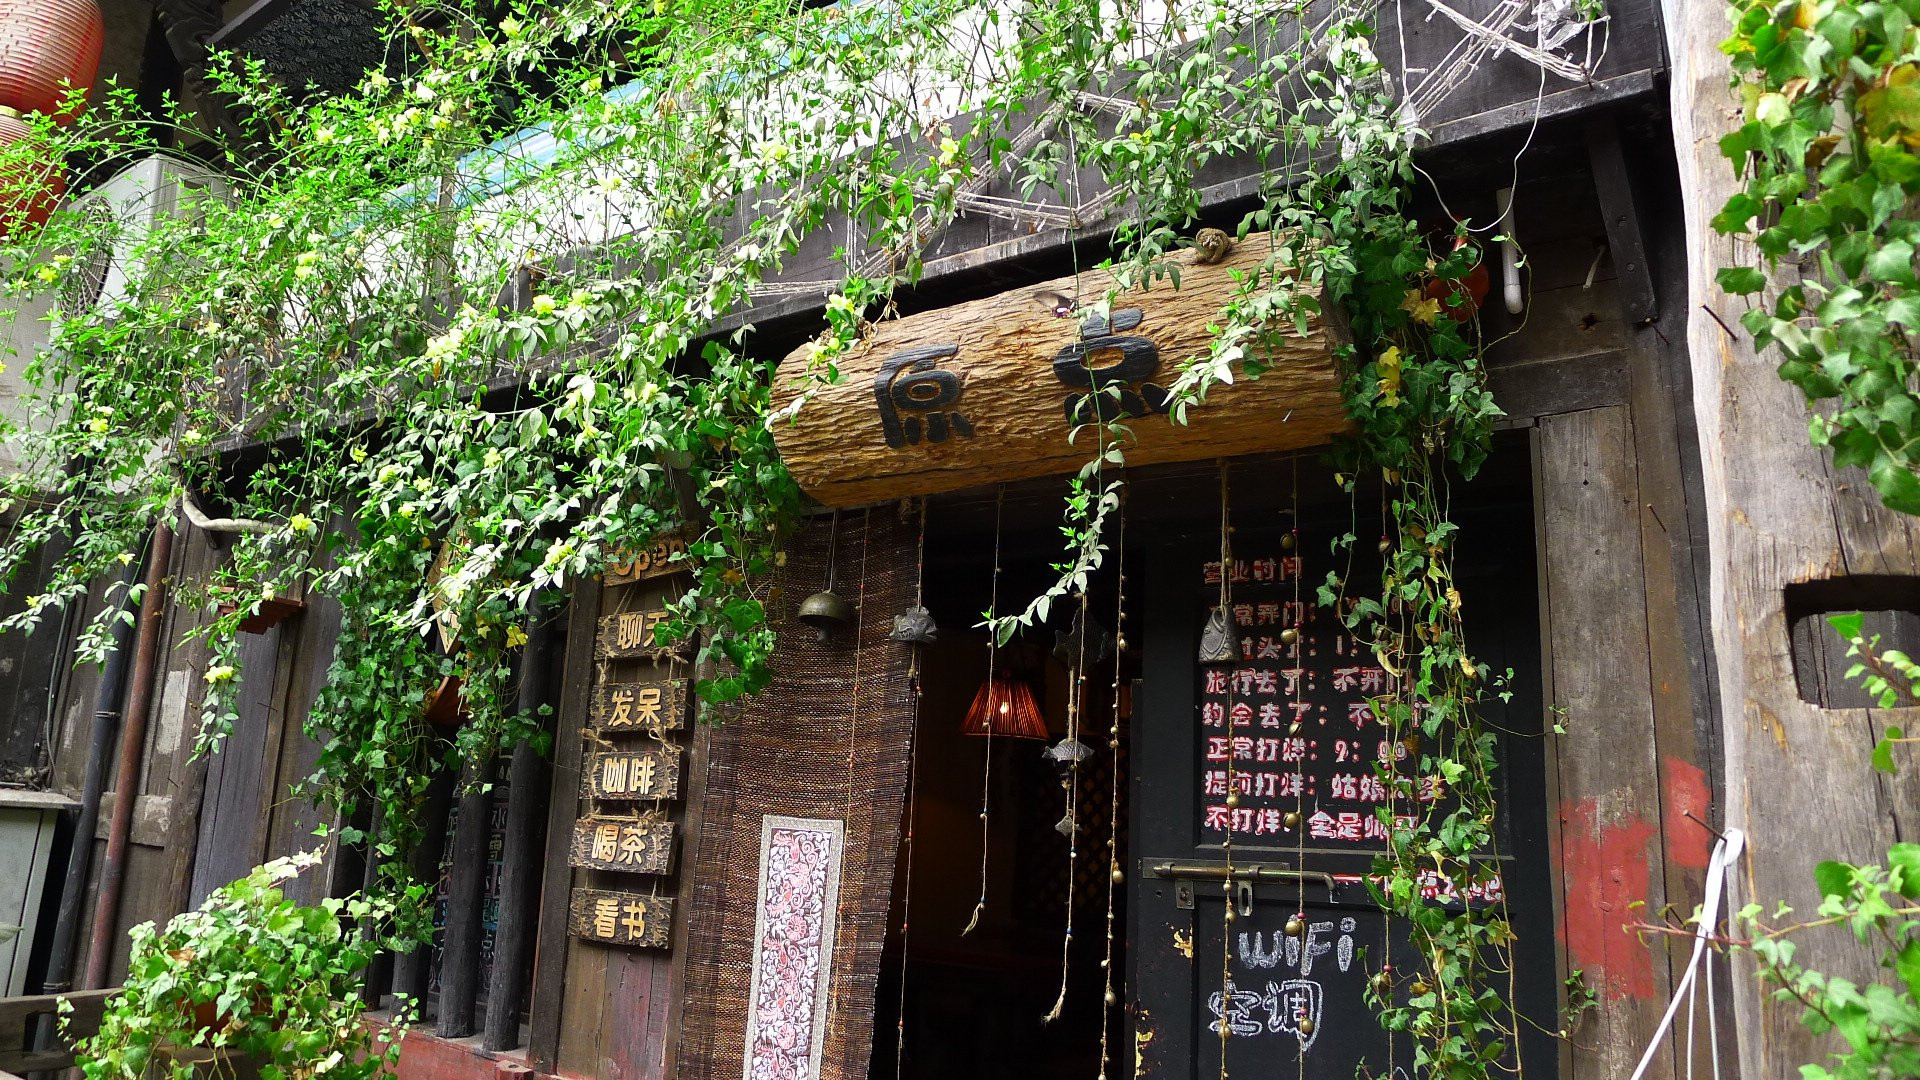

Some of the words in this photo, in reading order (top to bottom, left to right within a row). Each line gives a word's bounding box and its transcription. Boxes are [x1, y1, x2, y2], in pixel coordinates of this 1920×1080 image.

[612, 538, 686, 580] Open
[1202, 555, 1304, 585] 营业时间
[617, 610, 670, 650] 聊天
[1208, 599, 1318, 629] 常开门：
[608, 688, 663, 728] 发呆
[1348, 702, 1432, 731] 不门
[602, 756, 656, 795] 咖啡
[592, 824, 648, 866] 喝茶
[594, 897, 648, 941] 看书
